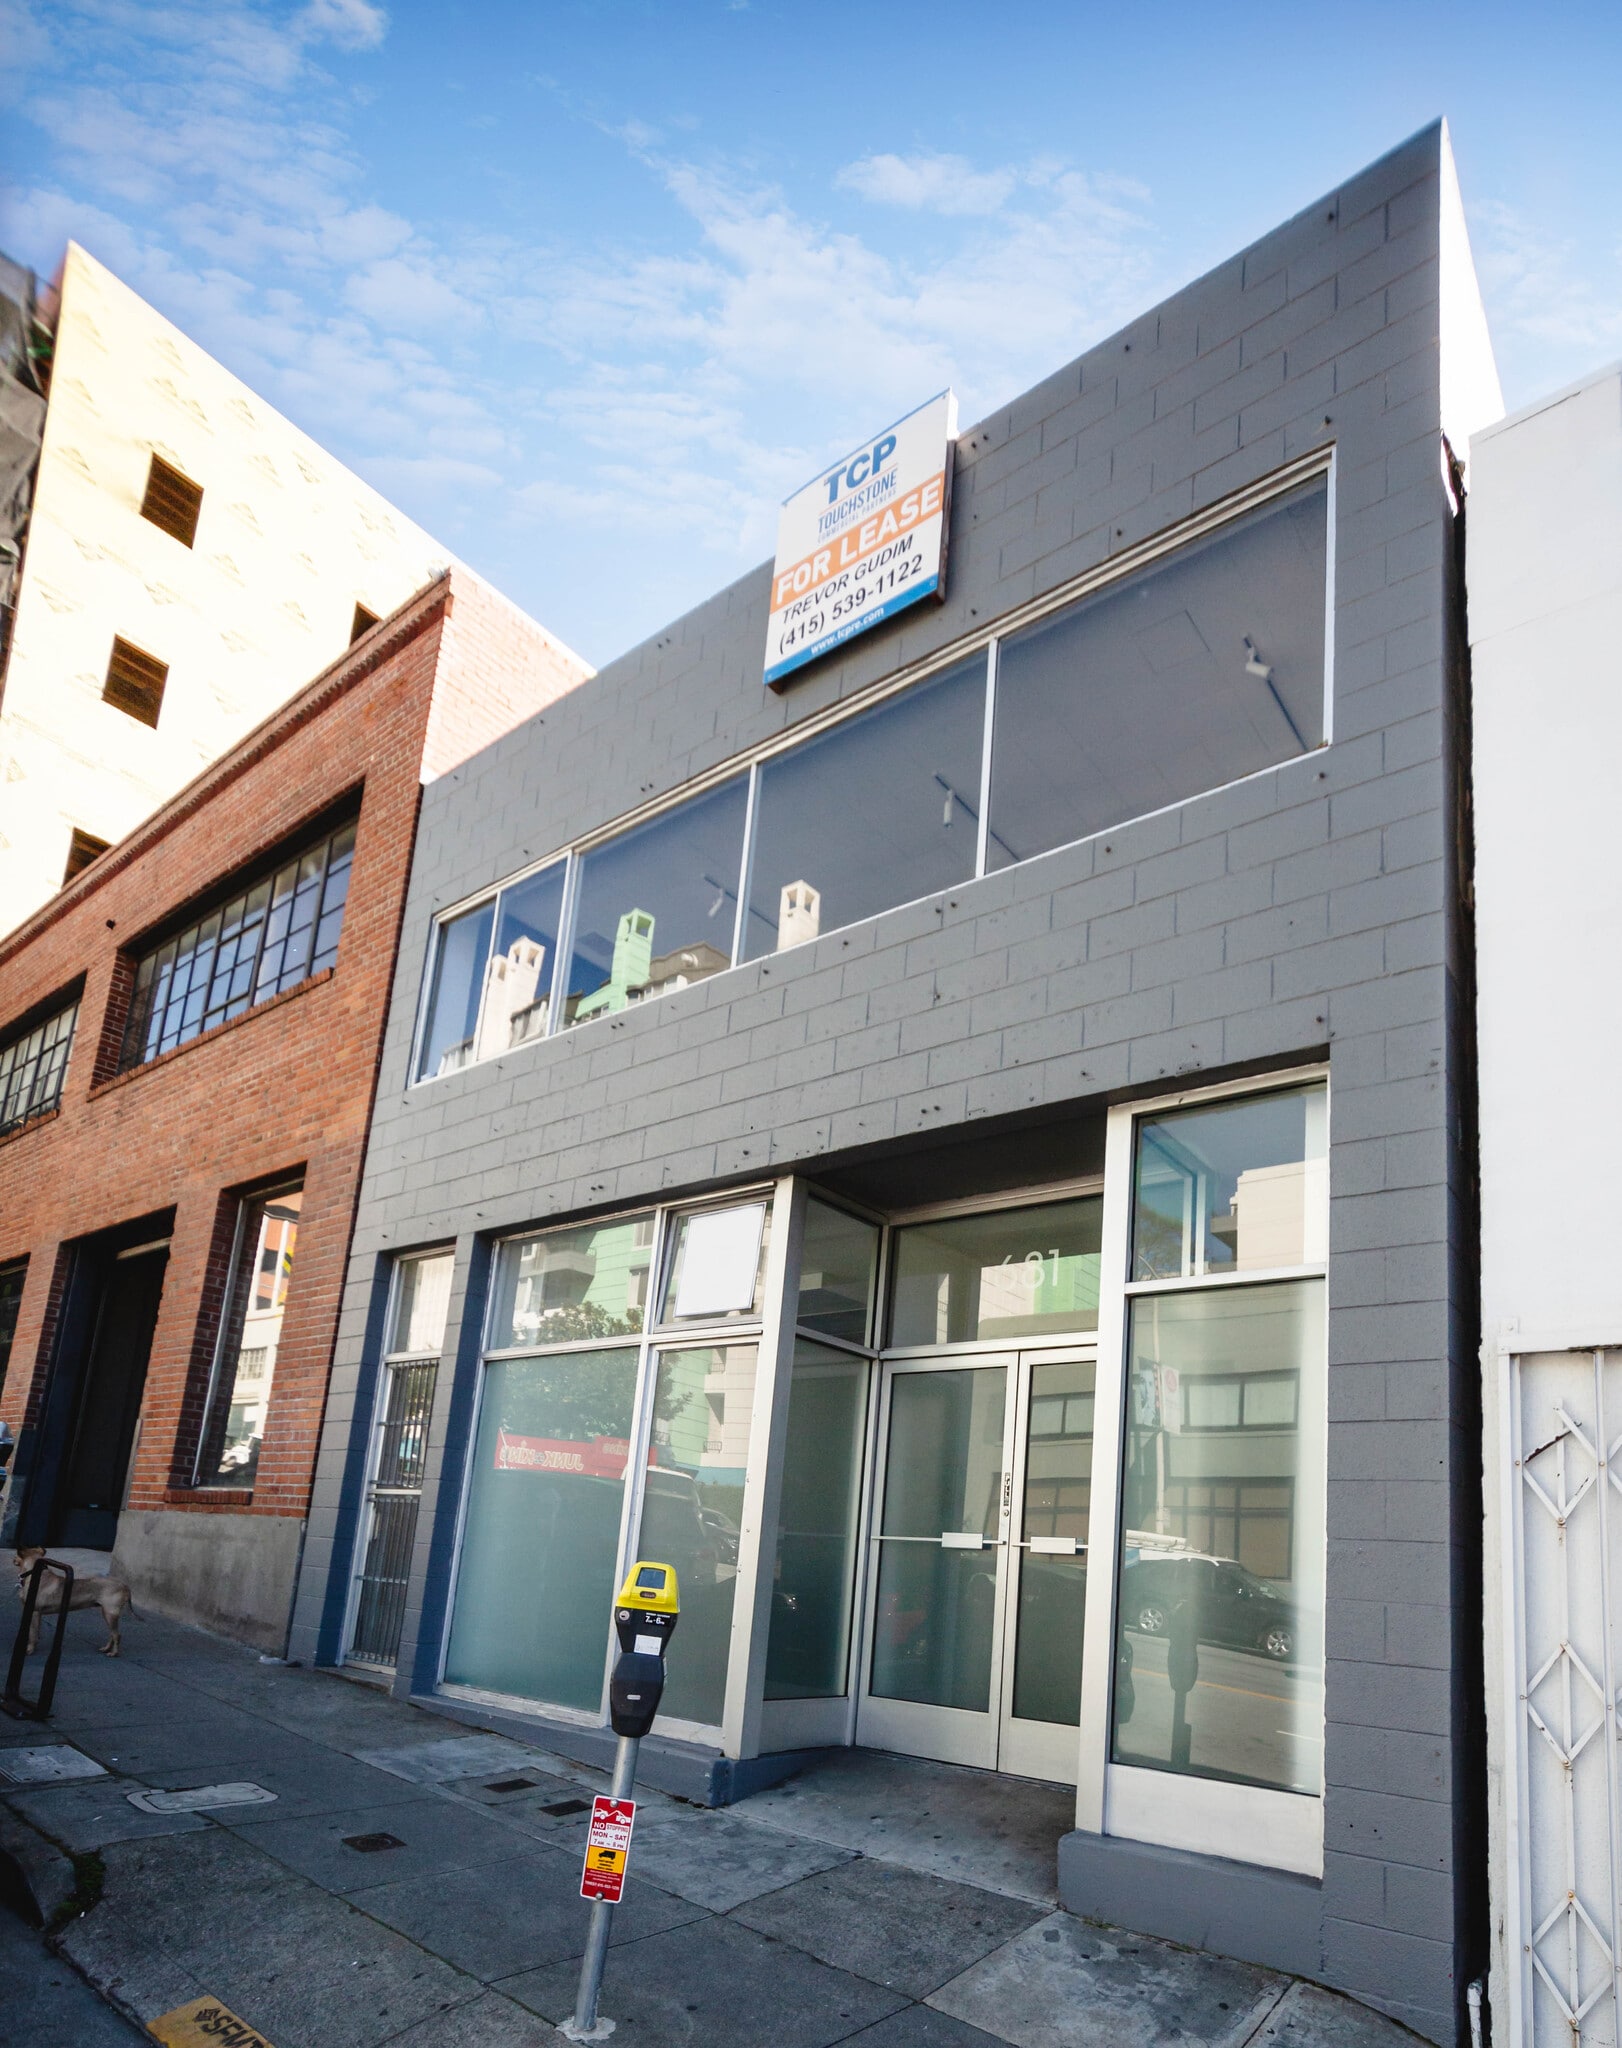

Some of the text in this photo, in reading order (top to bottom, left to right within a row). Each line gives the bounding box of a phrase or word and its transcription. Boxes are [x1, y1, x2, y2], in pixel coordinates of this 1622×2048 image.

[818, 467, 898, 533] TOUCHSTONE
[824, 434, 897, 504] TCP
[776, 478, 942, 605] FOR LEASE
[780, 553, 923, 654] (415) 539-1122
[783, 533, 913, 624] TREVOR GUDIM
[593, 1831, 608, 1839] MON
[594, 1822, 629, 1833] NO STOPPING
